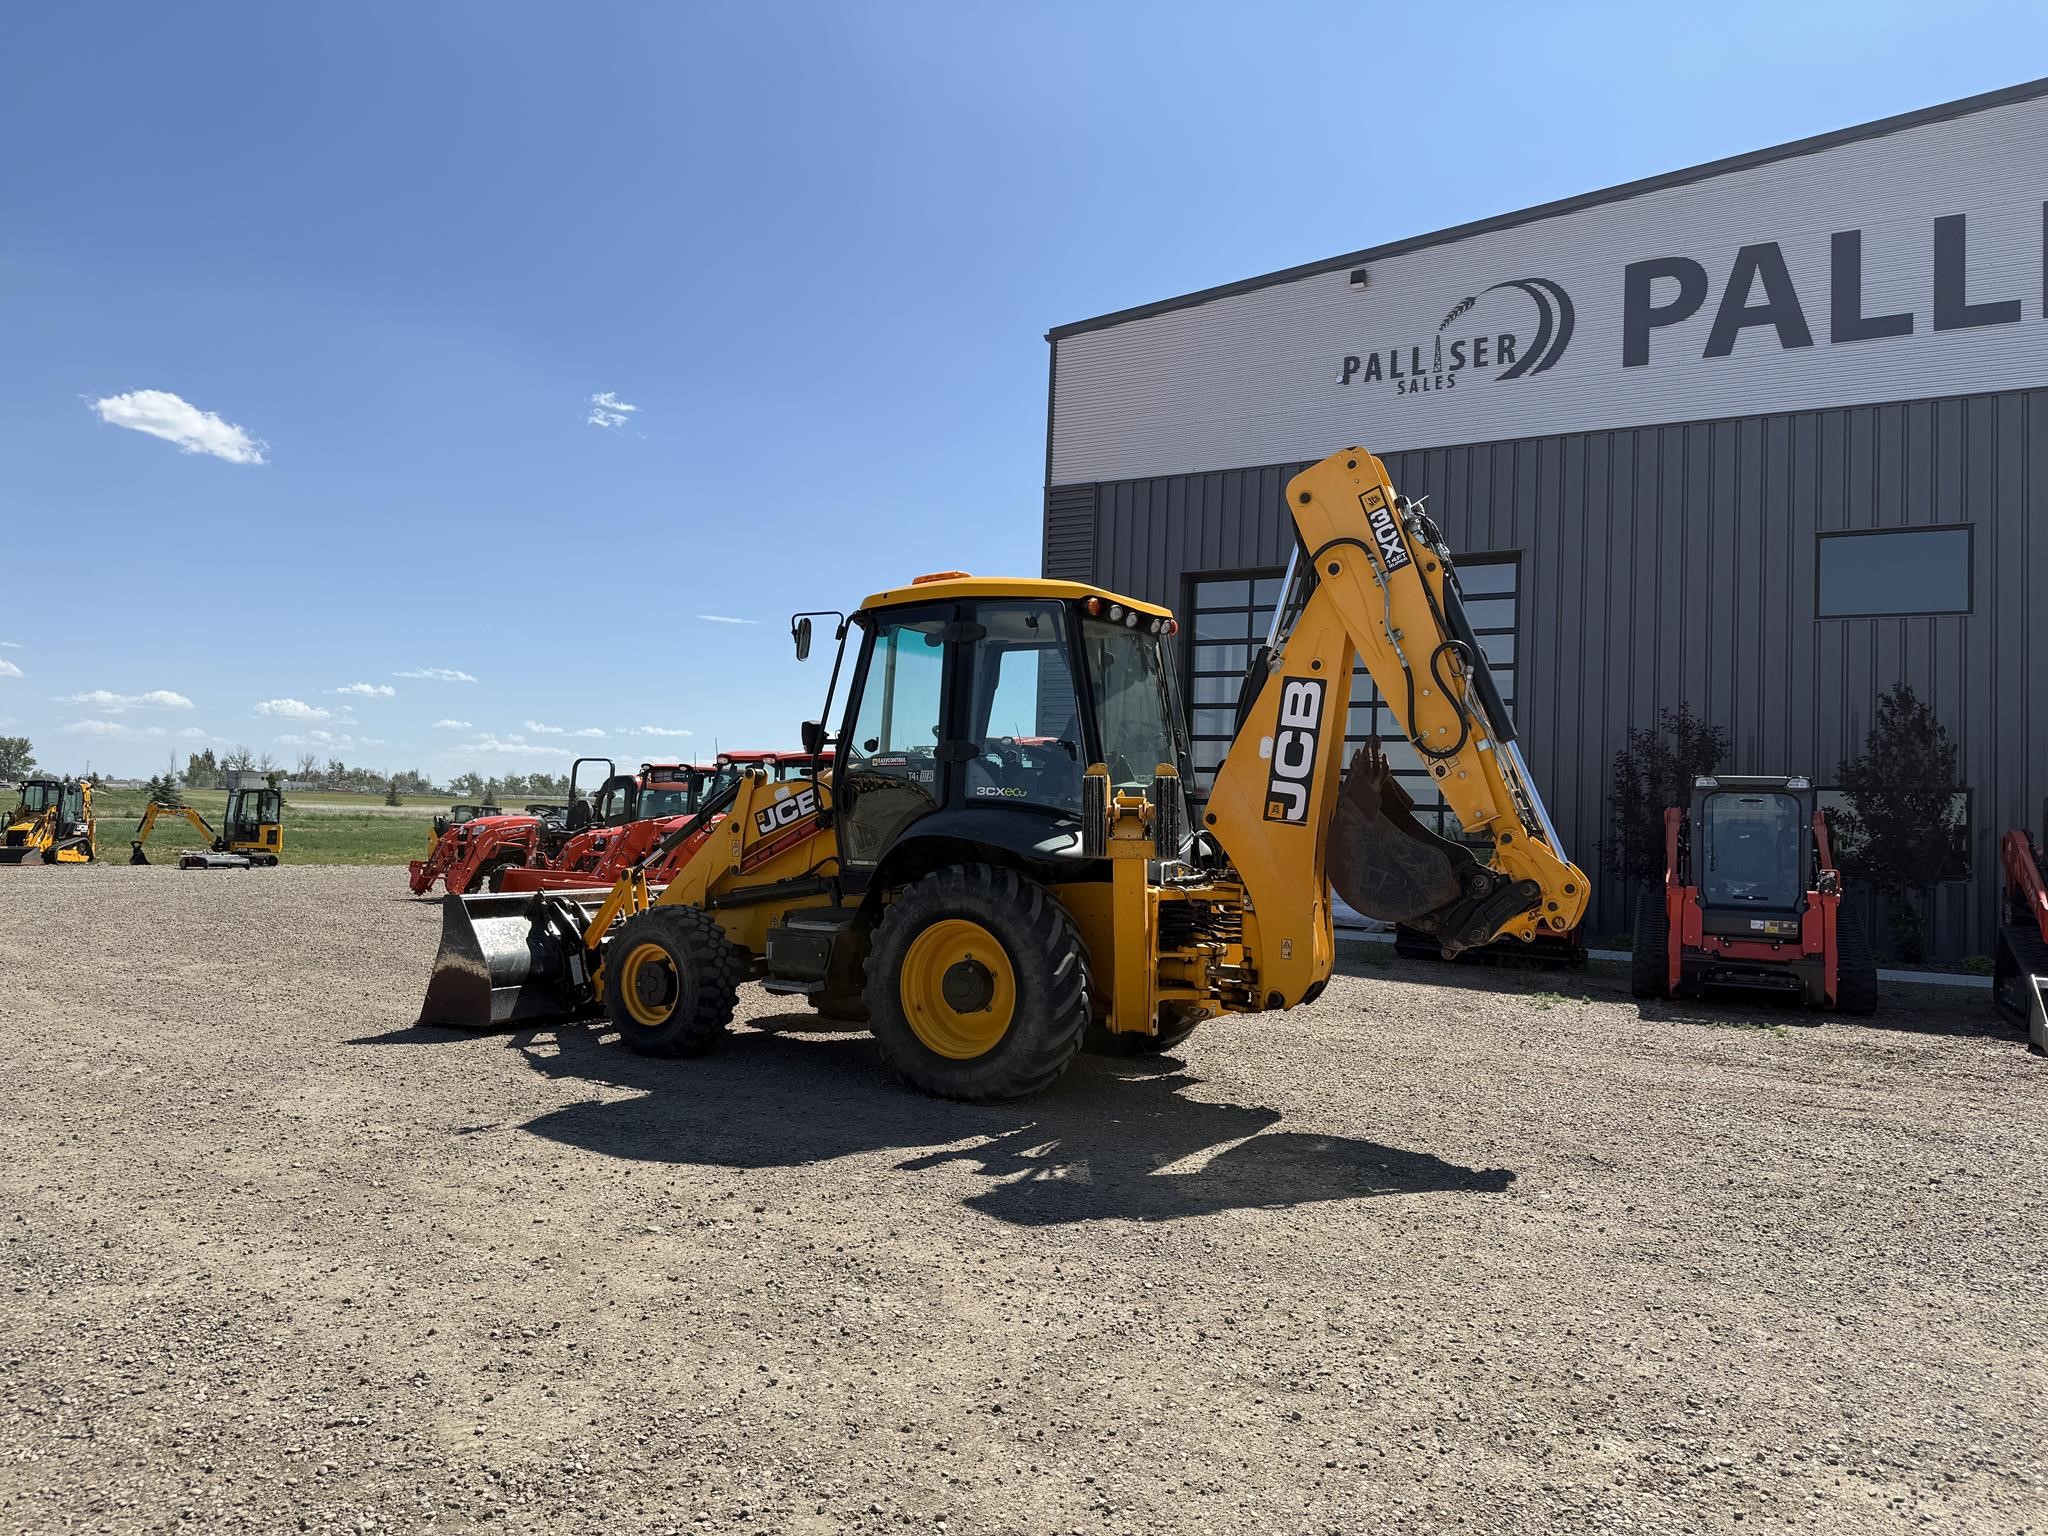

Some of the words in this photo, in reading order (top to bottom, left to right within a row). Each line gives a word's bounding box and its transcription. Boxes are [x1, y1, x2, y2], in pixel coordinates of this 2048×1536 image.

[1623, 201, 2048, 367] PALL
[1343, 334, 1516, 385] PALLISER
[1397, 374, 1455, 395] SALES
[1370, 508, 1406, 560] 3CX
[1386, 552, 1407, 565] 14FT
[1271, 681, 1321, 821] JCB
